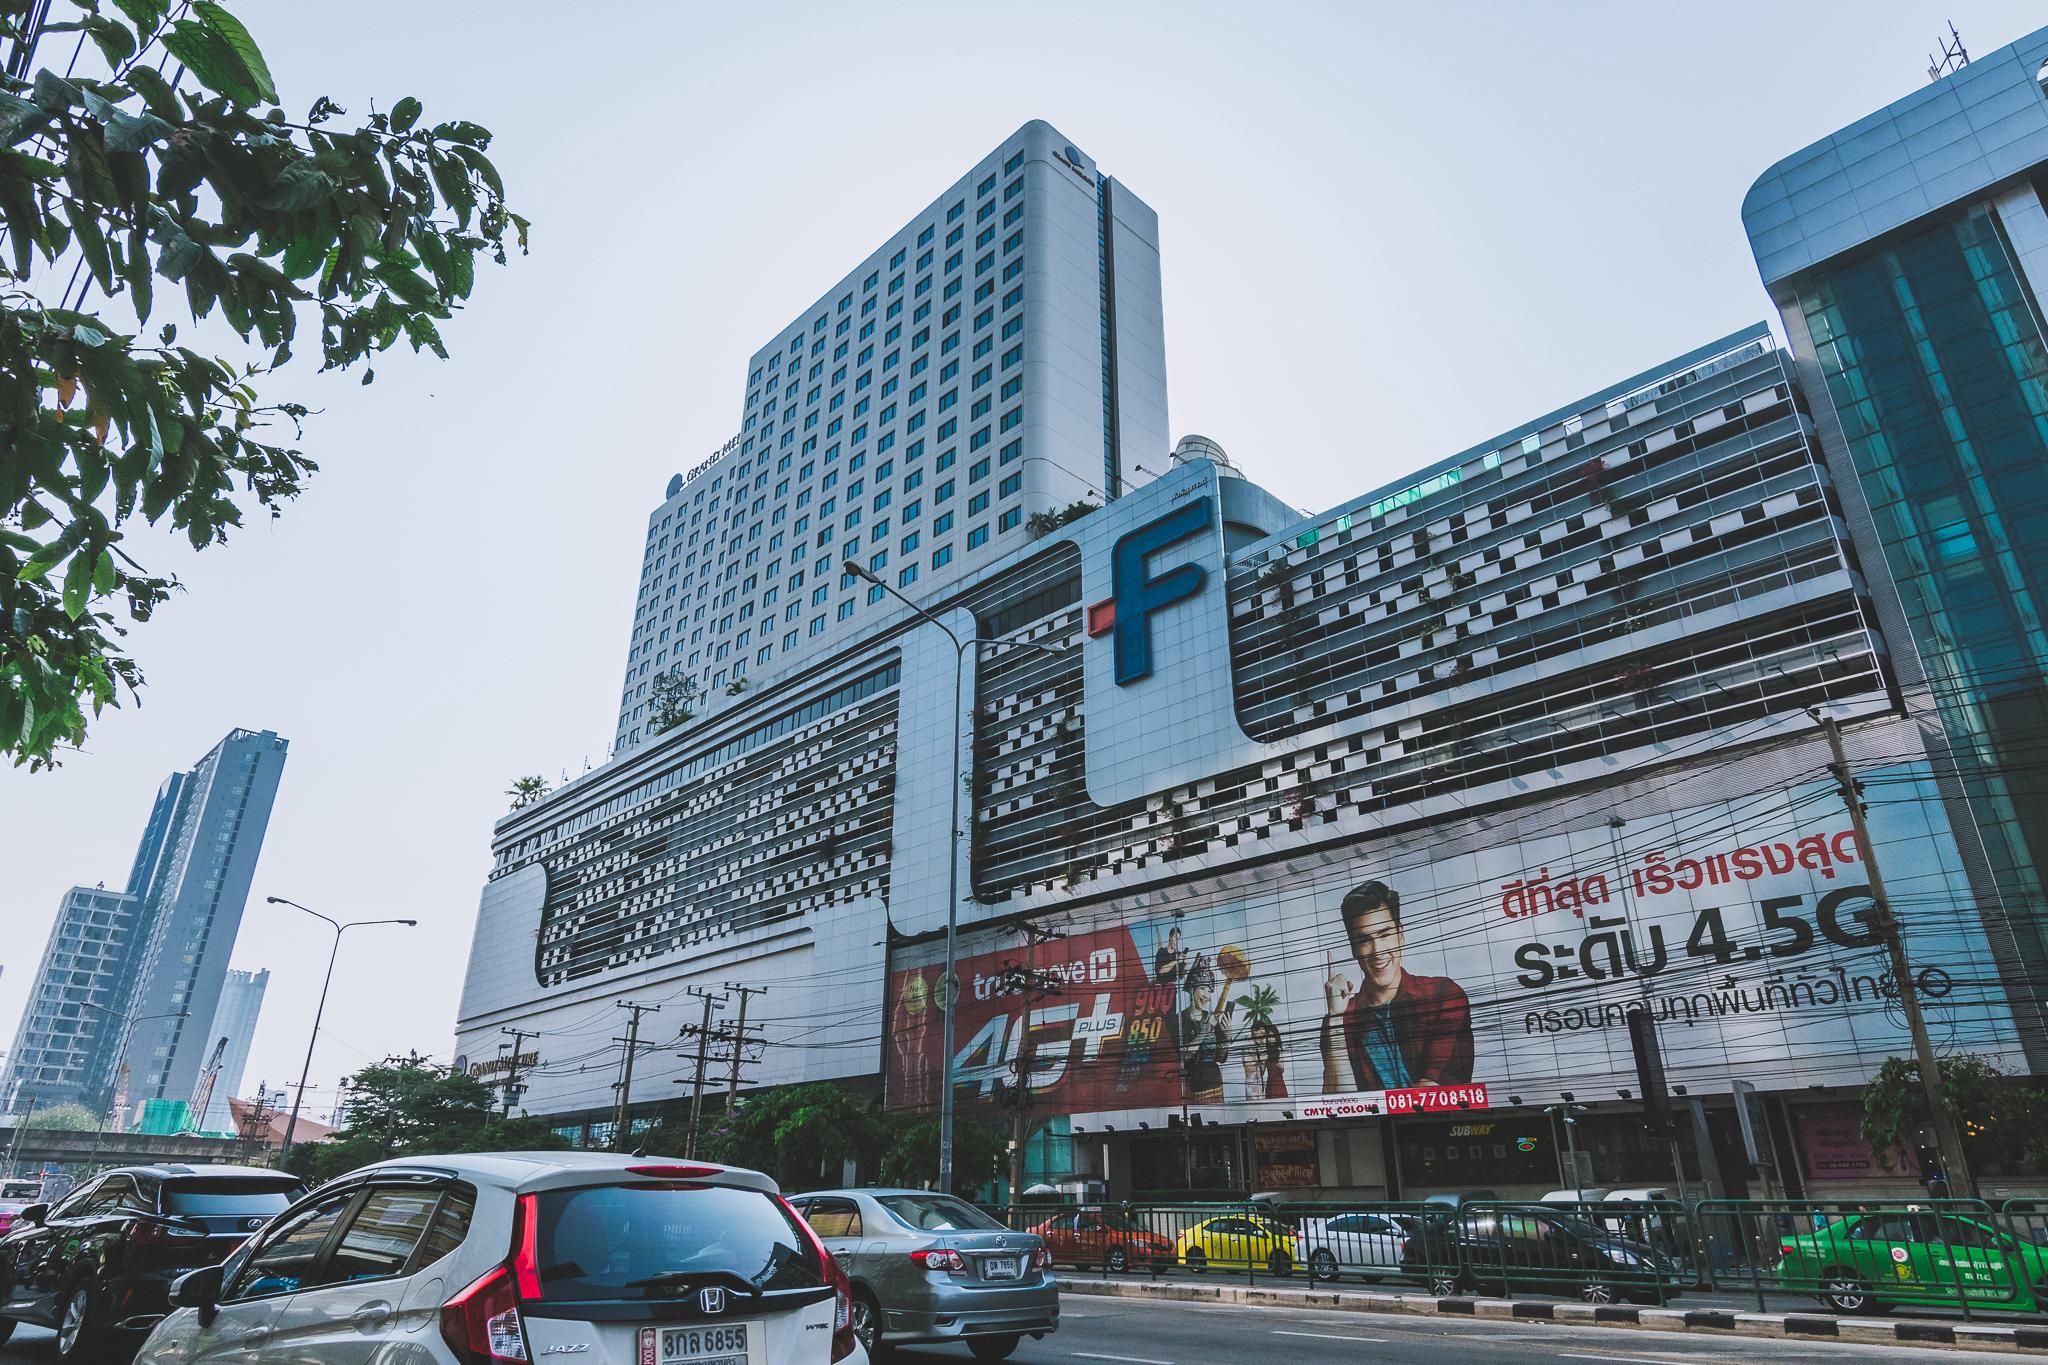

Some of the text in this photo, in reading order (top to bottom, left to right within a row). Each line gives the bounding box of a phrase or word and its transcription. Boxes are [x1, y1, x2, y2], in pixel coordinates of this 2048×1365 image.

[1501, 829, 1863, 918] ดีที่สุด เร็วแรงสุด
[1514, 884, 1887, 989] ระดับ 4.5G
[1079, 1018, 1117, 1034] PLUS
[1127, 1016, 1162, 1045] 850
[1304, 1106, 1332, 1117] CMYK
[1388, 1088, 1484, 1110] 081-7708518
[1449, 1124, 1495, 1137] SUBWAY
[540, 1343, 591, 1356] JAZZ
[664, 1328, 745, 1358] 3กล 6855
